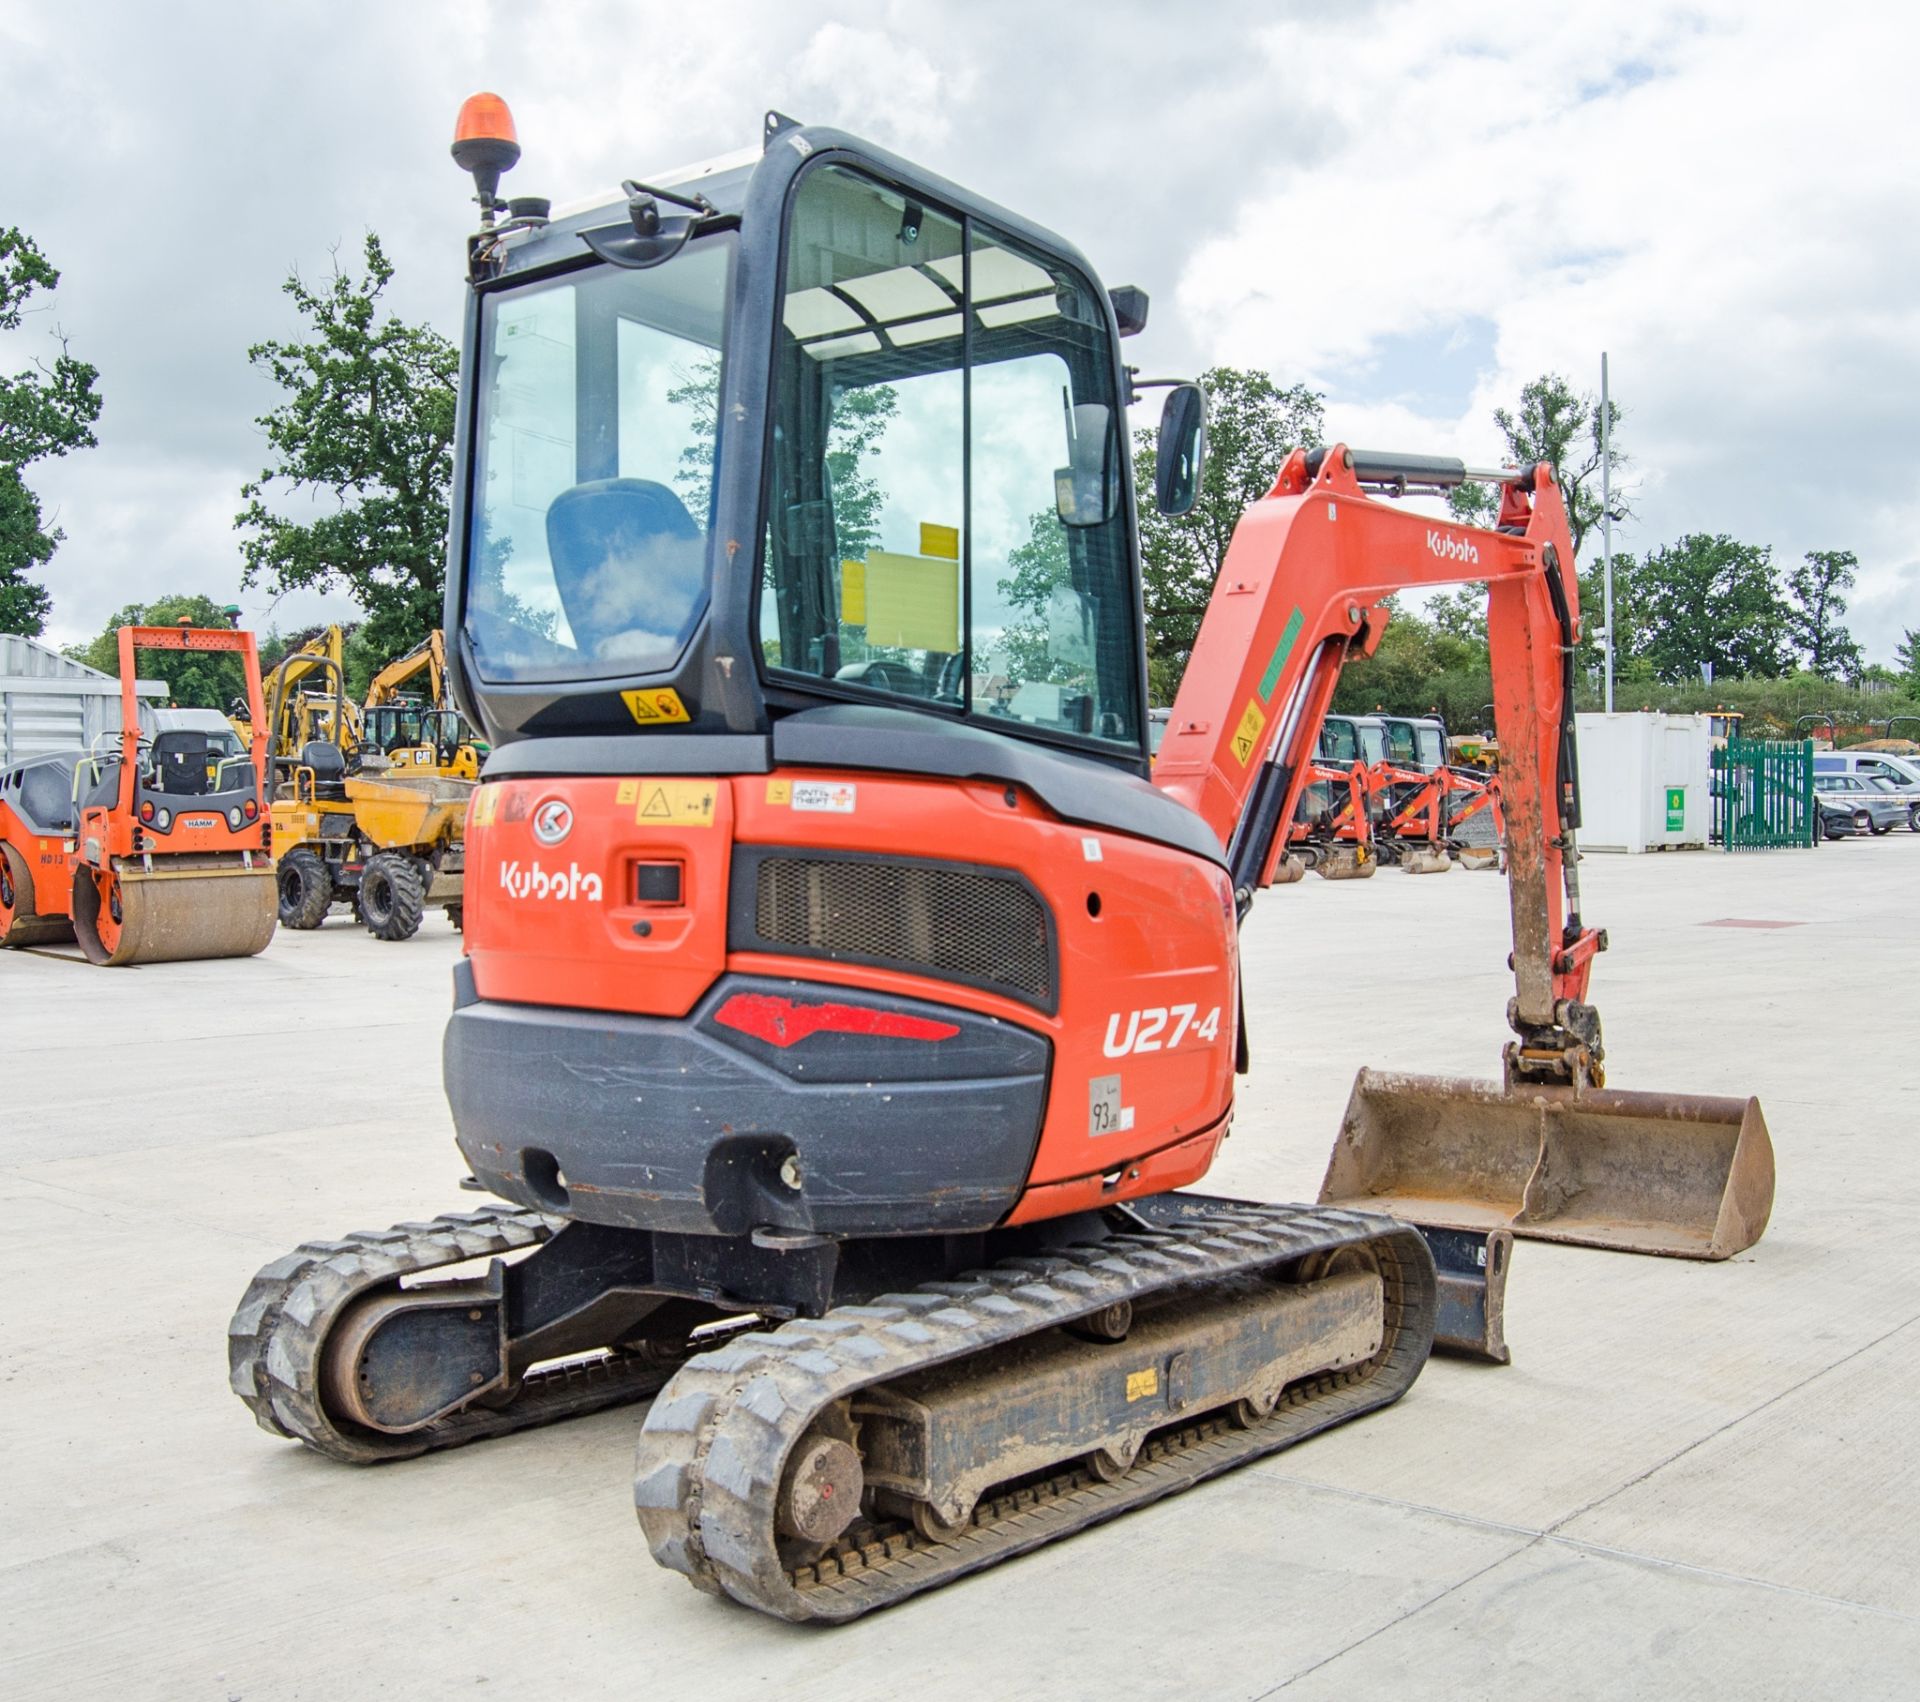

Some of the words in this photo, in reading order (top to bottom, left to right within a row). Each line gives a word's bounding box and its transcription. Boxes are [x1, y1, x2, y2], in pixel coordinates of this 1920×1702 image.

[1427, 529, 1479, 564] Kubota
[501, 860, 603, 901] Kubota
[1103, 1003, 1221, 1059] U27-4
[1093, 1101, 1110, 1131] 93
